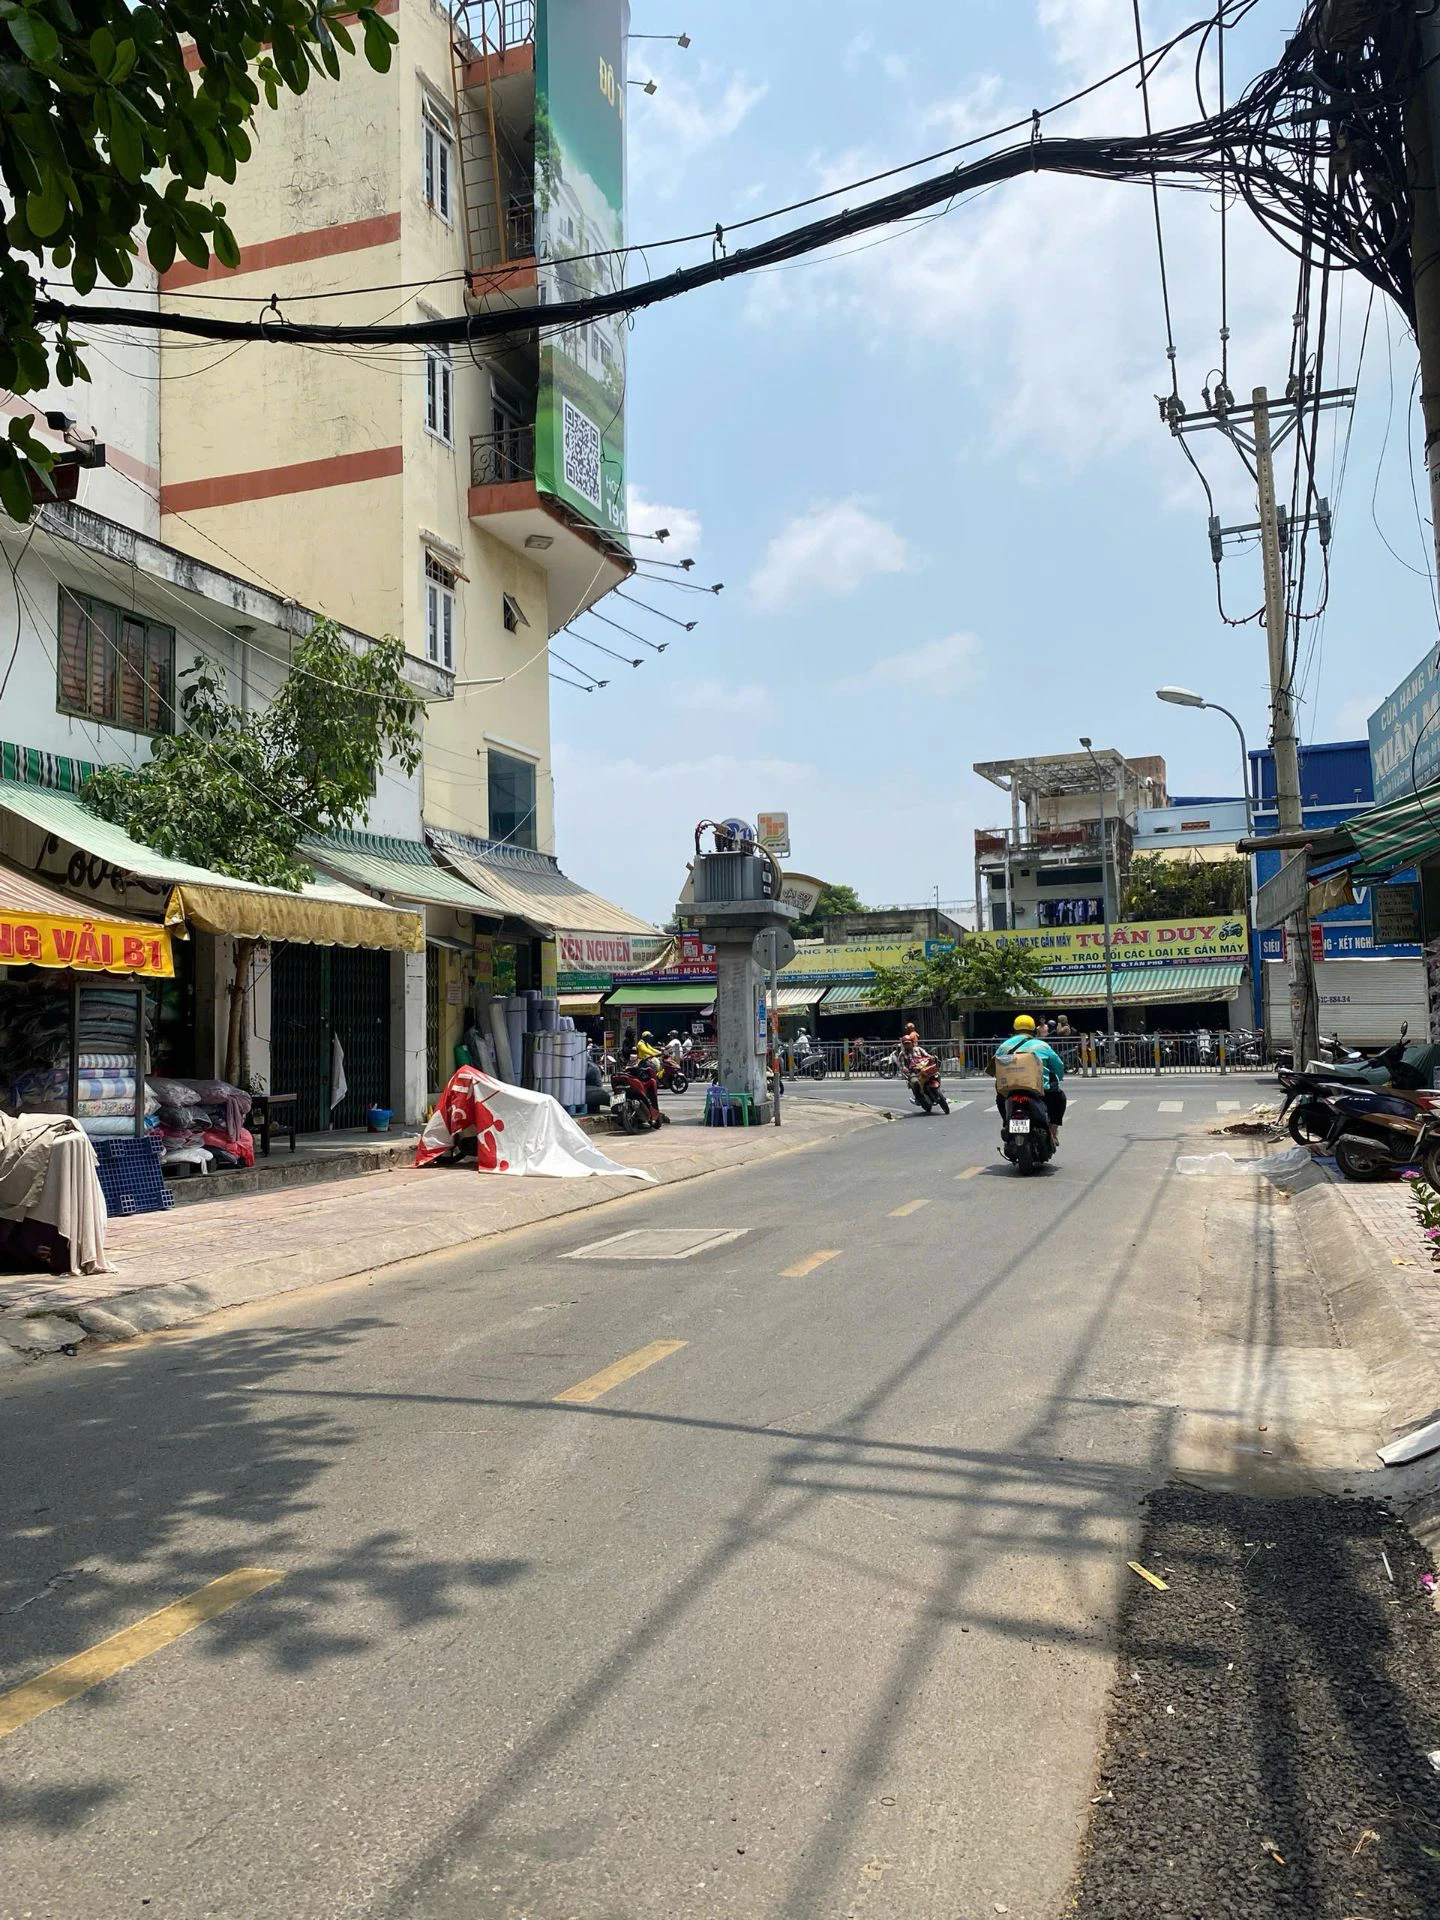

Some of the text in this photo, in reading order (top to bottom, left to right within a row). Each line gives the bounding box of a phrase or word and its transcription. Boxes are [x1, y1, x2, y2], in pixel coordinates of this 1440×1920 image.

[52, 922, 113, 966] VẢI
[123, 936, 163, 970] B1
[1031, 936, 1039, 949] XE
[1076, 925, 1217, 948] TUẤN DUY
[1263, 938, 1281, 953] SIÊU
[1339, 935, 1353, 950] XÉT
[1072, 953, 1099, 962] TRAO
[1124, 946, 1145, 959] CÁC
[1149, 948, 1173, 959] LOẠI
[1177, 946, 1191, 956] XE
[1220, 943, 1244, 954] MÁY
